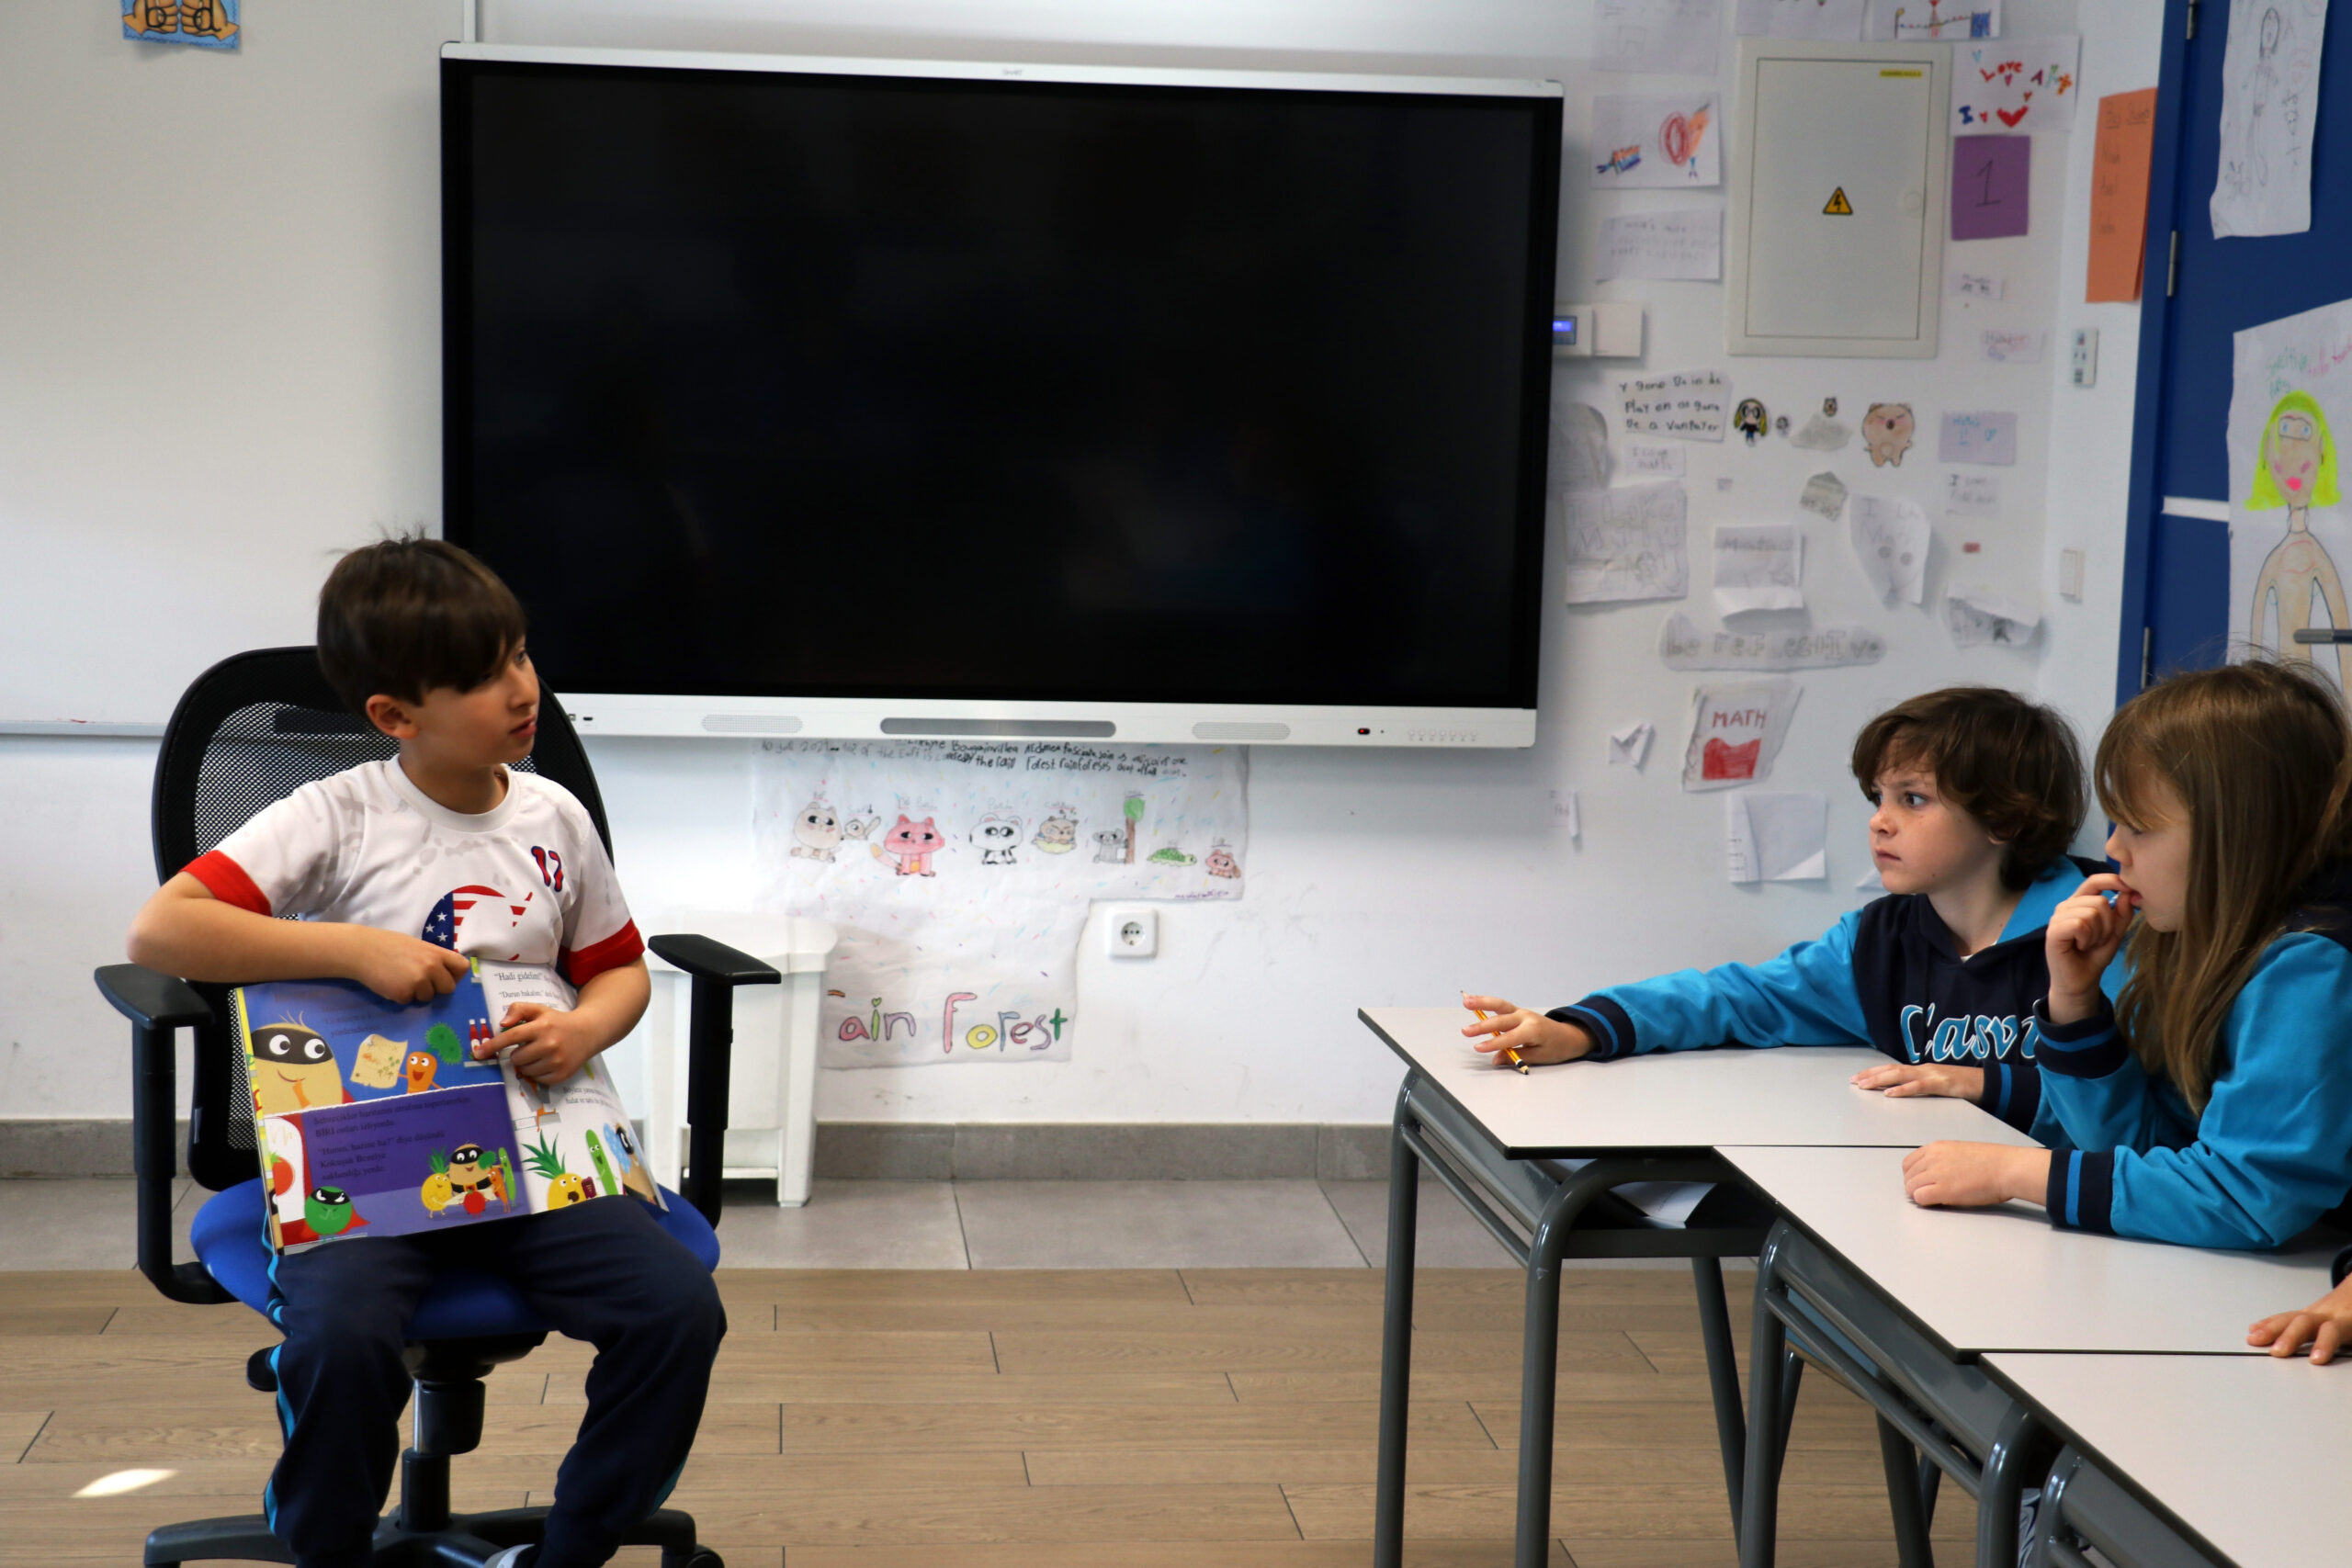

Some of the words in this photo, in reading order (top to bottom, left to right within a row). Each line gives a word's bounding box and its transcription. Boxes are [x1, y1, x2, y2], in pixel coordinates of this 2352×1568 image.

[1973, 158, 2002, 209] 1
[1712, 708, 1769, 730] MATH
[530, 846, 564, 892] 17
